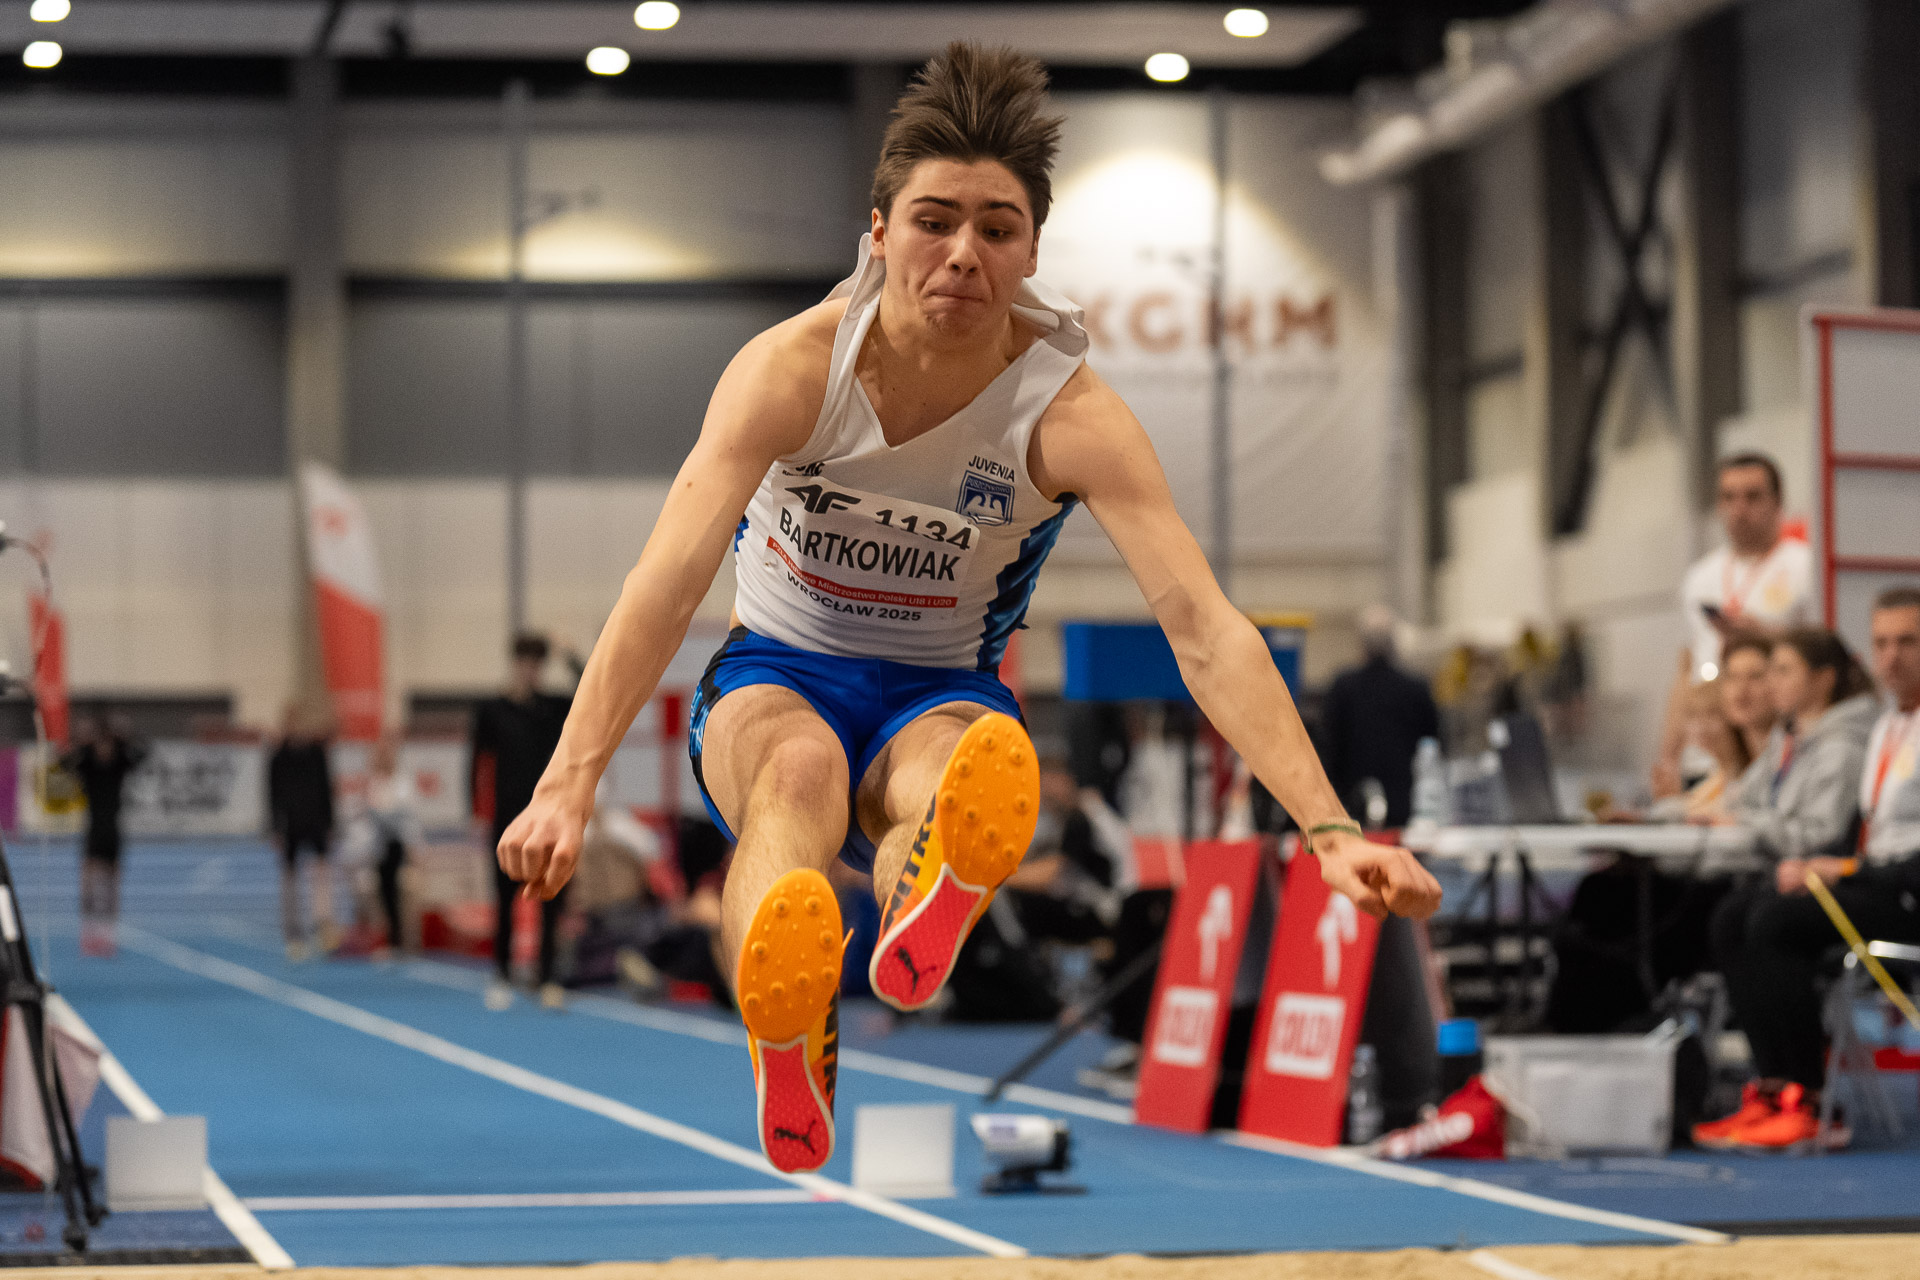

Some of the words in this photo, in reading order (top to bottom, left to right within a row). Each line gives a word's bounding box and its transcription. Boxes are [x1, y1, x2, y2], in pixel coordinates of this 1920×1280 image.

[968, 455, 1015, 482] JUVENIA
[780, 507, 961, 581] BARTKOWIAK
[875, 509, 971, 550] 1134
[787, 571, 875, 617] WROCŁAW
[878, 607, 922, 621] 2025
[818, 579, 877, 600] Mistrzostwa
[878, 593, 907, 604] Polski
[908, 597, 926, 606] U18
[932, 599, 953, 607] U20
